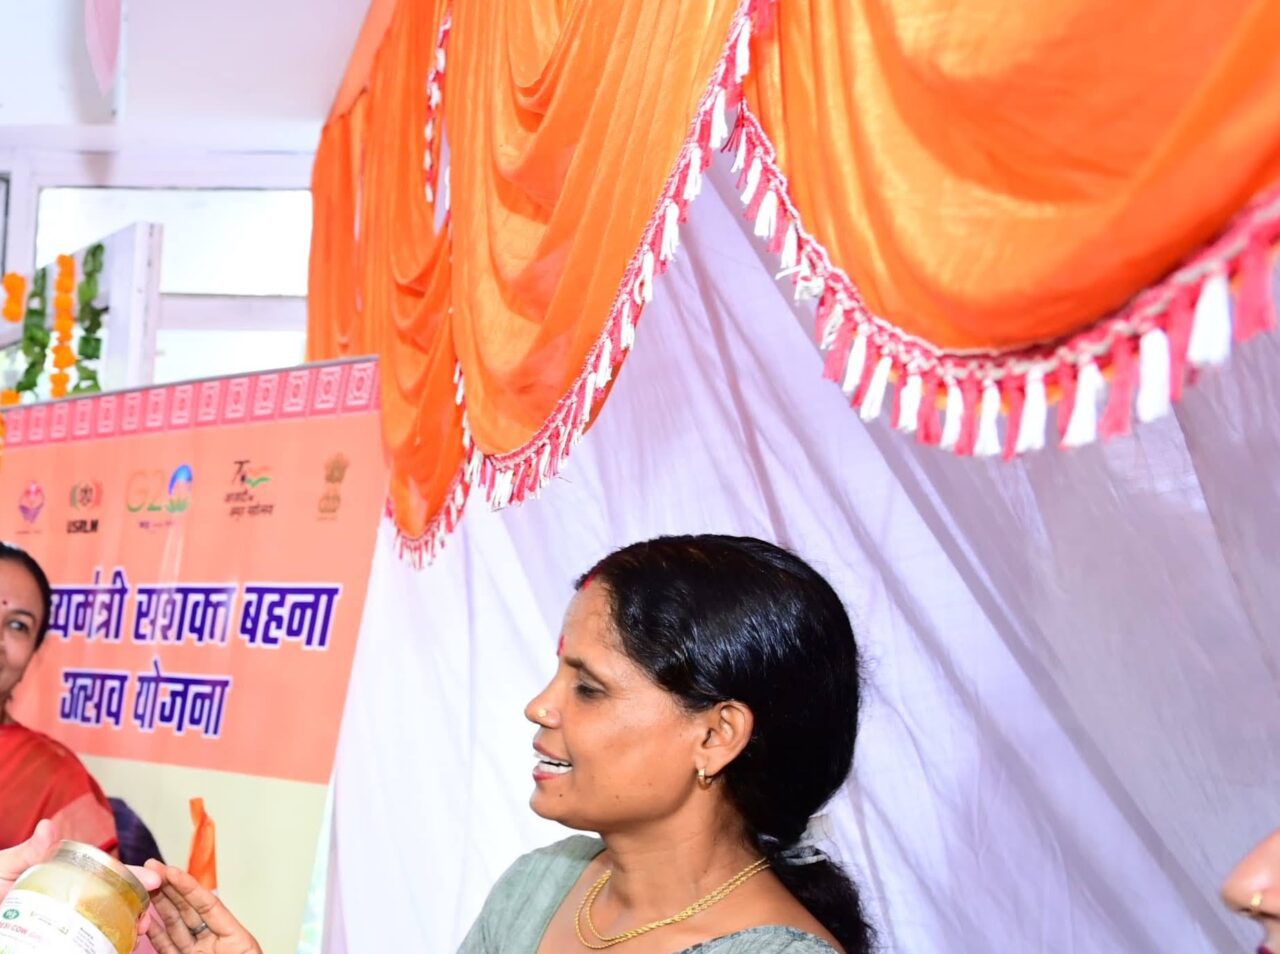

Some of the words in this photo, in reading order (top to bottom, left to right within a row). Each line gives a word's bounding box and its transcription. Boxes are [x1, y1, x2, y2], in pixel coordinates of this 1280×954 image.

[133, 587, 236, 642] सशक्त
[240, 586, 340, 647] बहना
[60, 671, 128, 726] उत्सव
[133, 659, 229, 736] योजना
